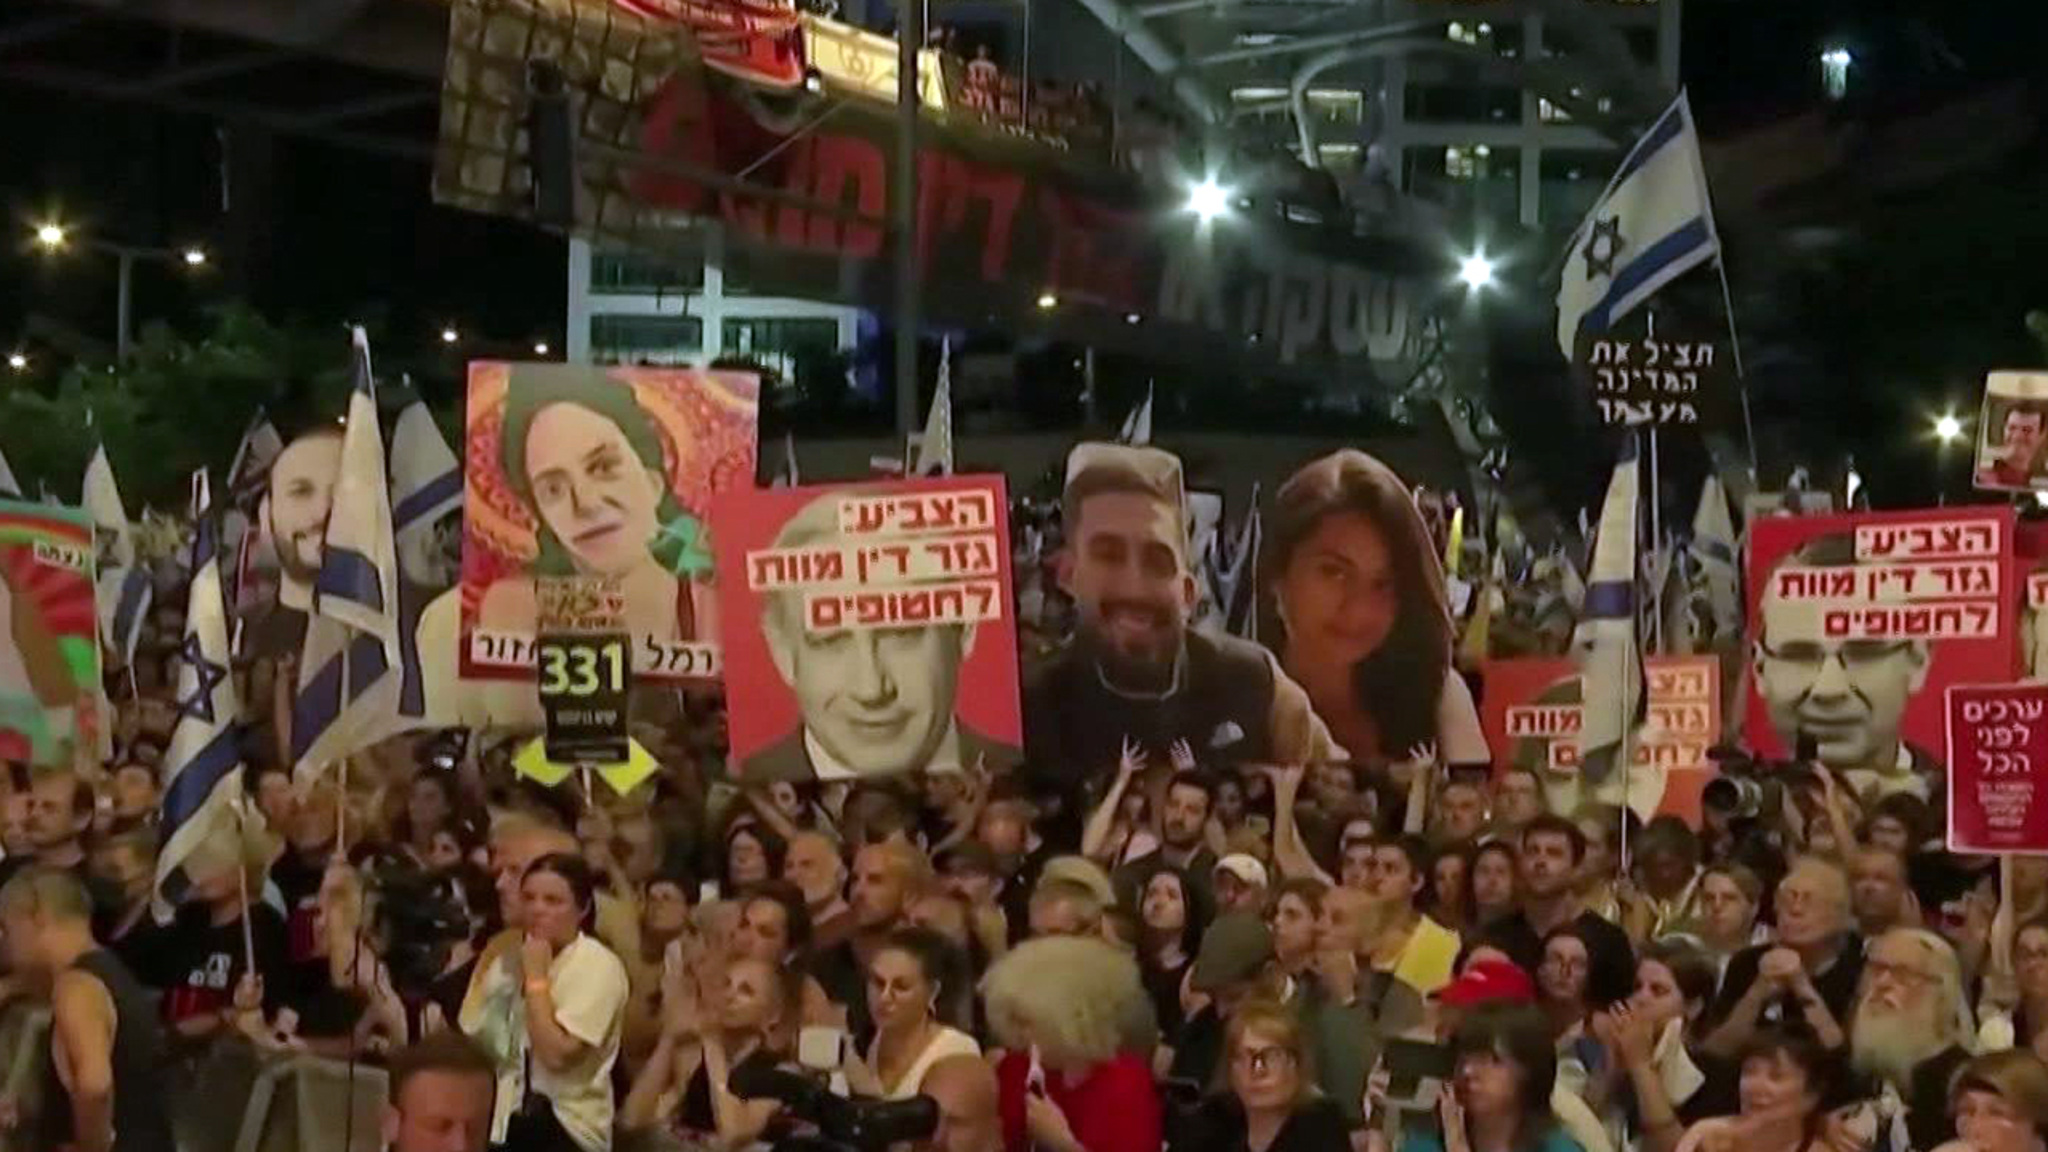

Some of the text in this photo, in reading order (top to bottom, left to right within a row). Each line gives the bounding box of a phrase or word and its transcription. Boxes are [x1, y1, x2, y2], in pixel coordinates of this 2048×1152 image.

[1589, 339, 1714, 367] תציל את
[1597, 368, 1698, 392] המדינה
[845, 495, 988, 534] הצביע:
[1859, 525, 1992, 556] הצביע:
[752, 541, 992, 585] גזר דין מוות
[1778, 566, 1993, 602] גזר דין מוות
[811, 585, 993, 628] לחטופים
[1824, 605, 1992, 637] לחטופים
[541, 642, 624, 695] 331
[1513, 706, 1582, 733] מוות
[1963, 699, 2043, 722] ערכים
[1976, 722, 2031, 747] לפני
[1976, 750, 2031, 774] הכל
